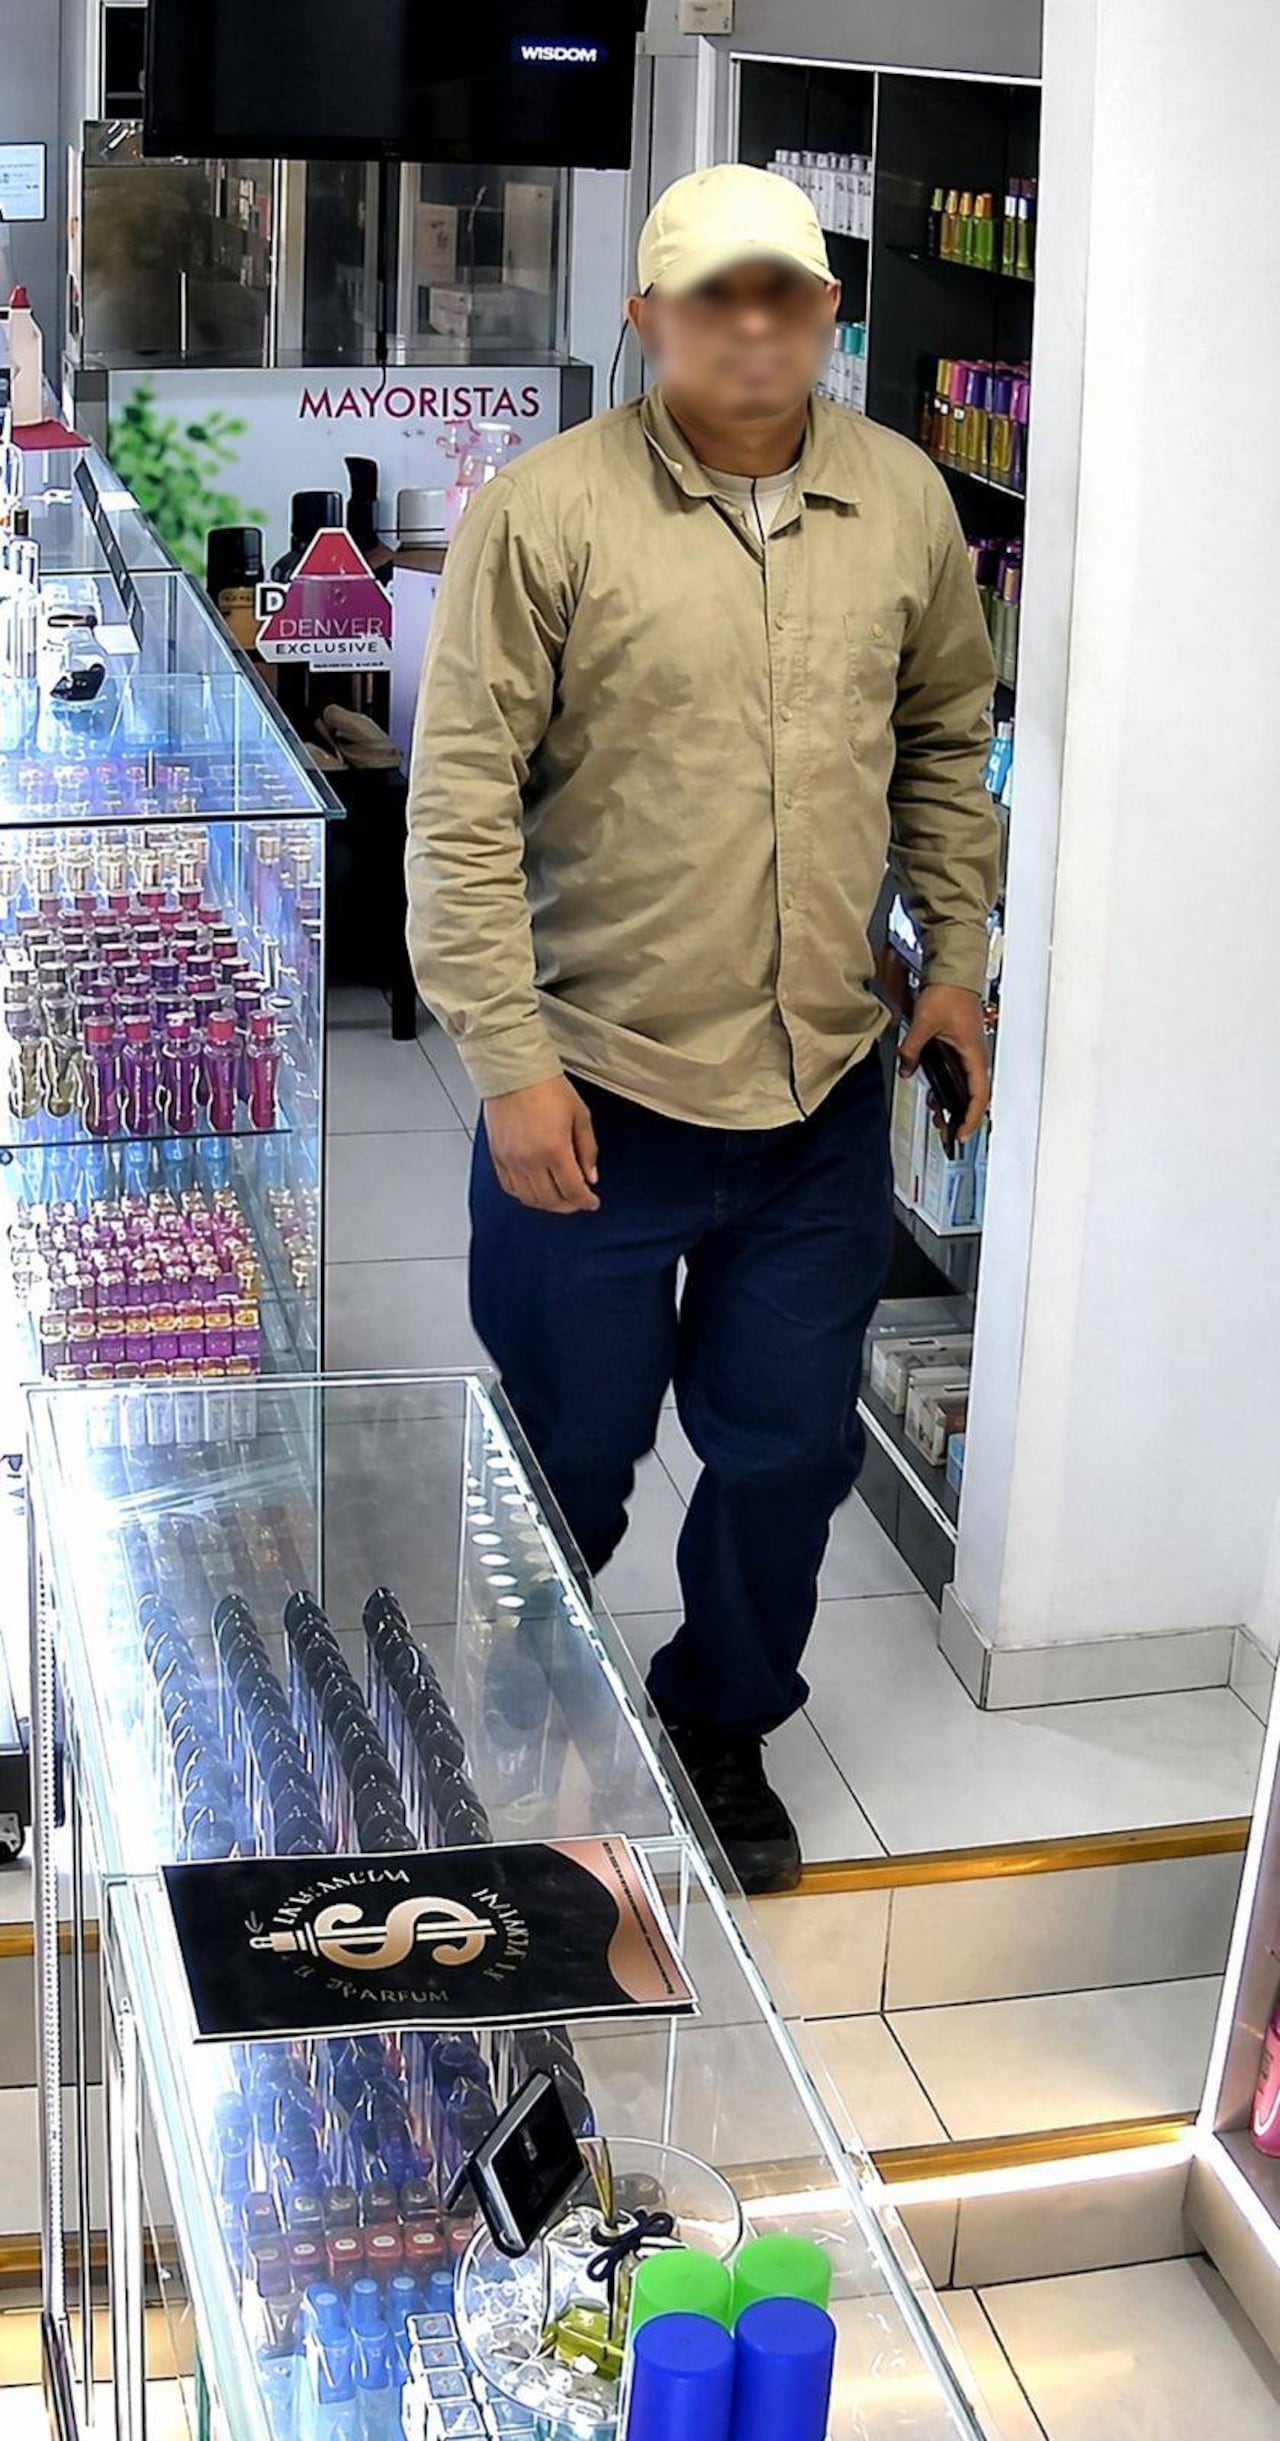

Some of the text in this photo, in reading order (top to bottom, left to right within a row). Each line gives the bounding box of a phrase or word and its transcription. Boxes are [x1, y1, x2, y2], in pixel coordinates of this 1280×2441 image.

[521, 46, 597, 62] WISDOM
[299, 387, 540, 419] MAYORISTAS
[279, 617, 384, 638] DENVER
[275, 641, 378, 655] EXCLUSIVE
